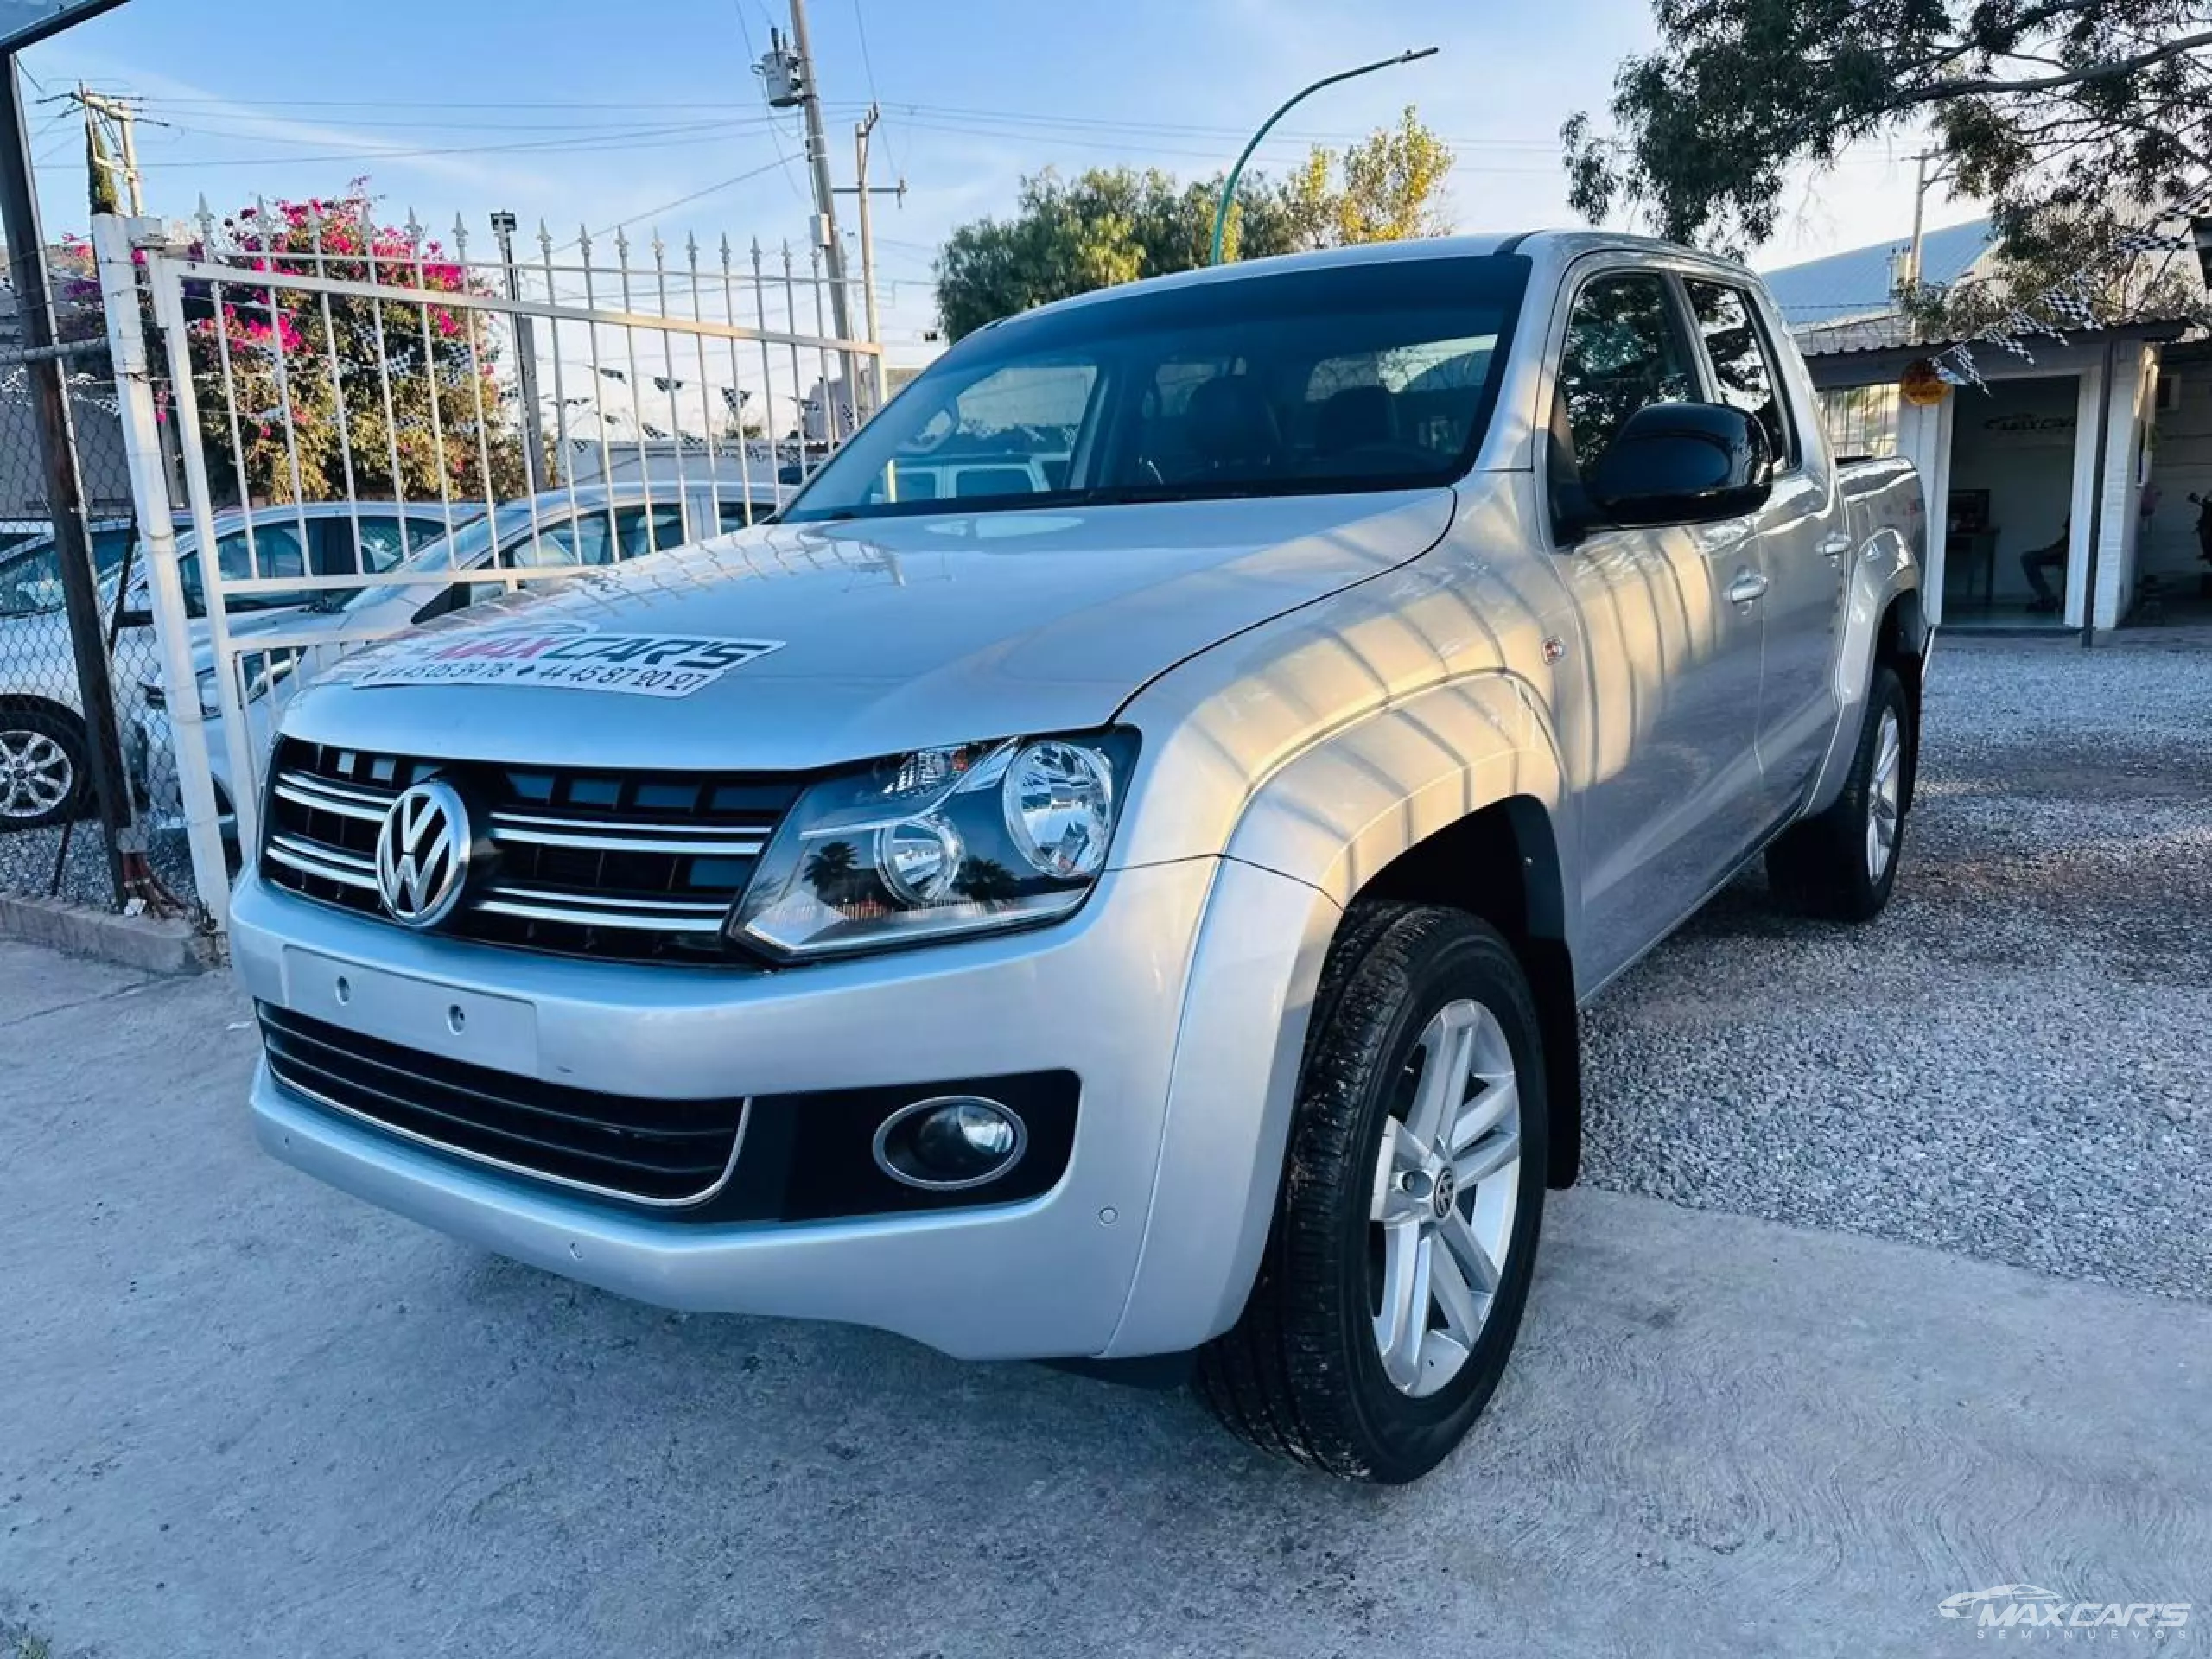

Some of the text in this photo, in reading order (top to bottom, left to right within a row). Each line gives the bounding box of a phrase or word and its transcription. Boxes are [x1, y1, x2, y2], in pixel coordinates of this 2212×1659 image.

[598, 666, 639, 683] 87
[664, 674, 709, 690] 97
[379, 785, 470, 925] VW
